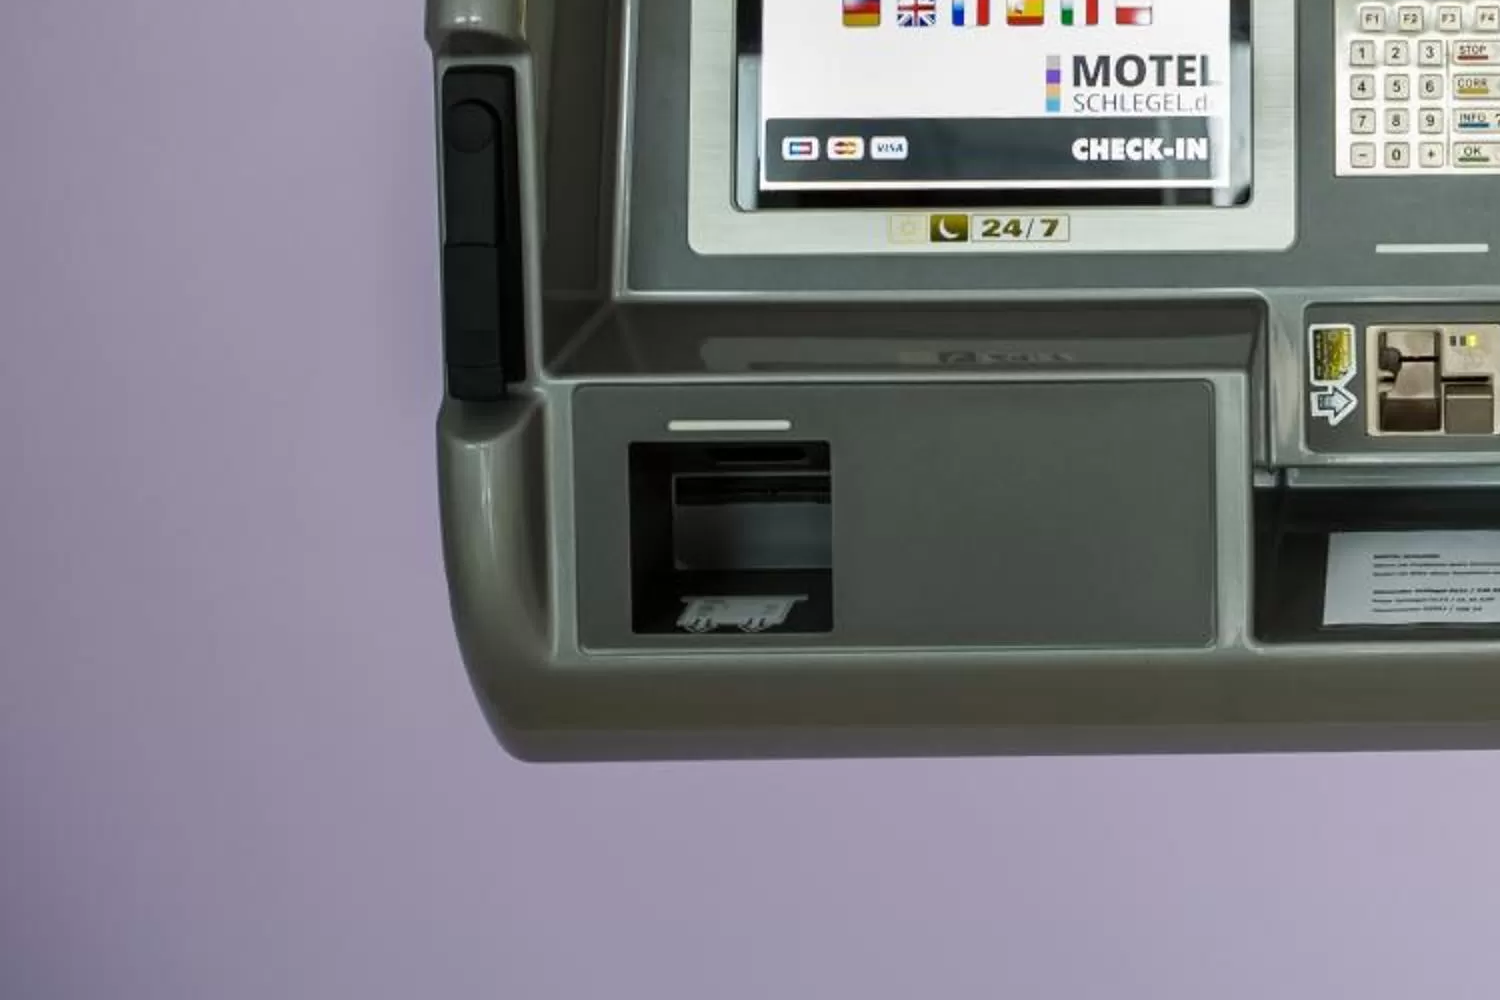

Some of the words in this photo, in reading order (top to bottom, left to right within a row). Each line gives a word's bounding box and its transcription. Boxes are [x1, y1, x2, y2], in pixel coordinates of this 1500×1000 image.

[1366, 13, 1380, 24] F1
[1403, 13, 1418, 24] F2
[1442, 13, 1456, 24] F3
[1480, 13, 1495, 23] F4
[1459, 46, 1486, 55] STOP
[1072, 54, 1222, 87] MOTEL
[1072, 93, 1213, 113] SCHLEGEL.d
[1459, 113, 1486, 122] INFO
[877, 143, 904, 153] VISA
[1071, 136, 1209, 161] CHECK-IN
[1463, 146, 1482, 156] OK
